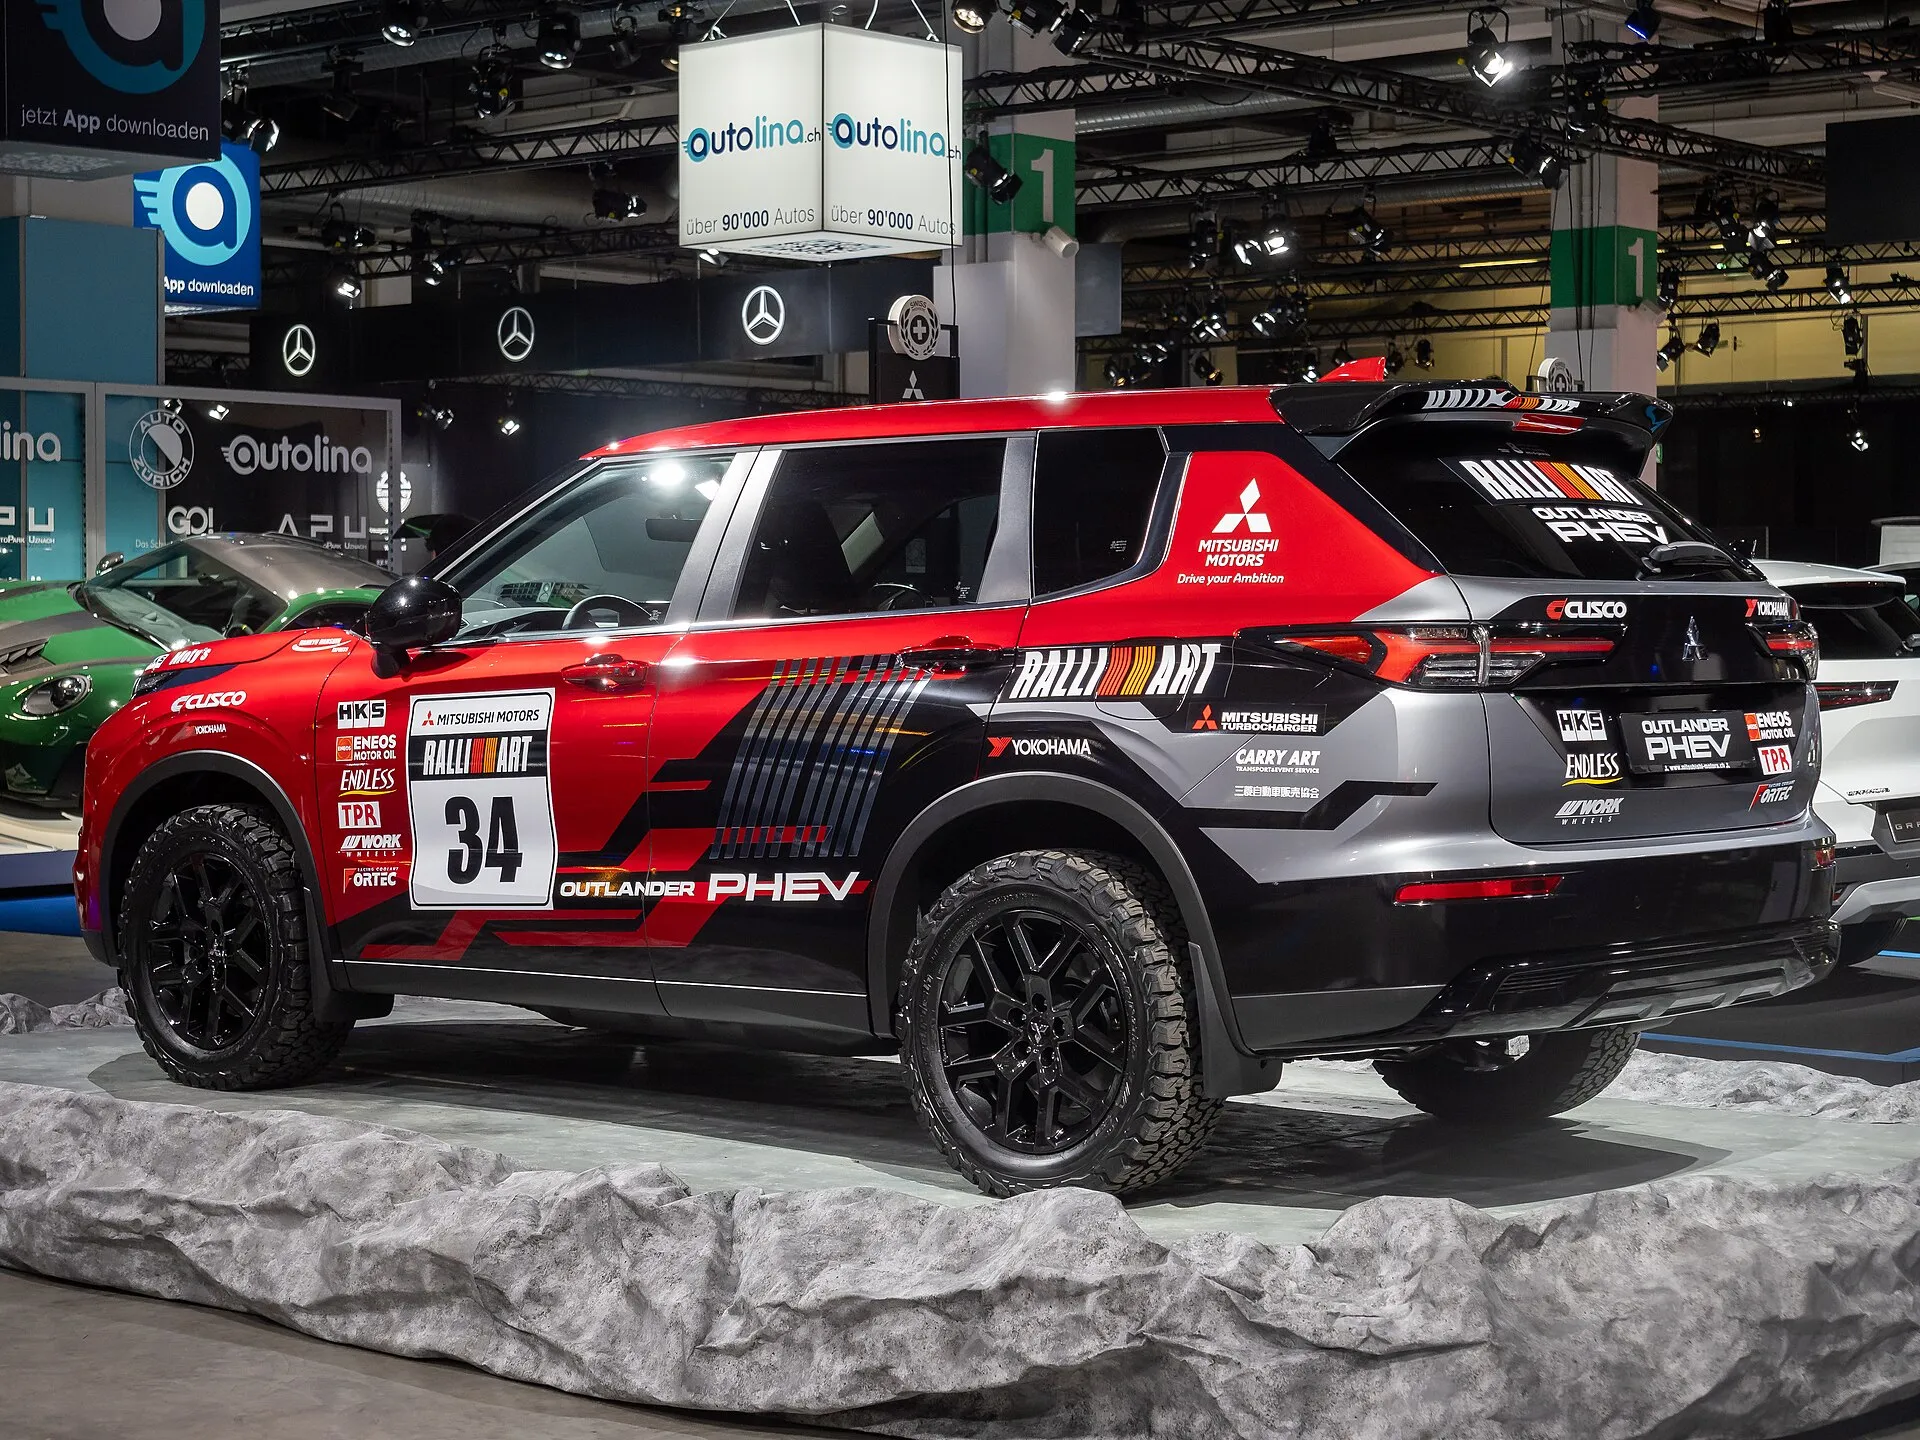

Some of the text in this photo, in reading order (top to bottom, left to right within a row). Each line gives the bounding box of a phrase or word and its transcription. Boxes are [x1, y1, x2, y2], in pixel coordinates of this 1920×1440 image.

[21, 104, 209, 141] jetzt App downloaden
[1030, 148, 1054, 223] 1
[686, 208, 815, 236] über 90'000 Autos
[831, 205, 956, 236] über 90'000 Autos
[1628, 237, 1643, 298] 1
[188, 278, 254, 296] downloaden
[910, 300, 927, 309] SWISS
[140, 413, 186, 435] AUTO
[133, 457, 190, 488] ZÜRICH
[168, 506, 214, 535] GO!
[1532, 507, 1658, 525] OUTLANDER
[1545, 521, 1669, 544] PHEV
[1198, 539, 1279, 553] MITSUBISHI
[1205, 554, 1264, 567] MOTORS
[1177, 572, 1285, 586] Drive your Ambition
[1757, 601, 1788, 616] YOKOHAMA
[338, 701, 385, 722] HKS
[436, 709, 540, 726] MITSUBISHI MOTORS
[1221, 711, 1318, 724] MITSUBISHI
[1756, 711, 1792, 728] ENEOS
[194, 724, 226, 735] YOKOHAMA
[1221, 722, 1317, 733] TURBOCHARGER
[1557, 711, 1605, 733] HKS
[1642, 718, 1729, 734] OUTLANDER
[354, 734, 397, 750] ENEOS
[1761, 728, 1796, 739] MOTOR OIL
[354, 750, 396, 760] MOTOR OIL
[1011, 739, 1091, 756] YOKOHAMA
[1644, 734, 1731, 760] PHEV
[1235, 749, 1320, 766] CARRY ART
[1565, 753, 1620, 779] ENDLESS
[1762, 748, 1790, 772] TPR
[340, 768, 395, 791] ENDLESS
[341, 804, 378, 827] TPR
[1561, 816, 1613, 825] WHEELS
[444, 796, 523, 884] 34
[345, 850, 397, 858] WHEELS
[559, 871, 860, 901] OUTLANDER PHEV
